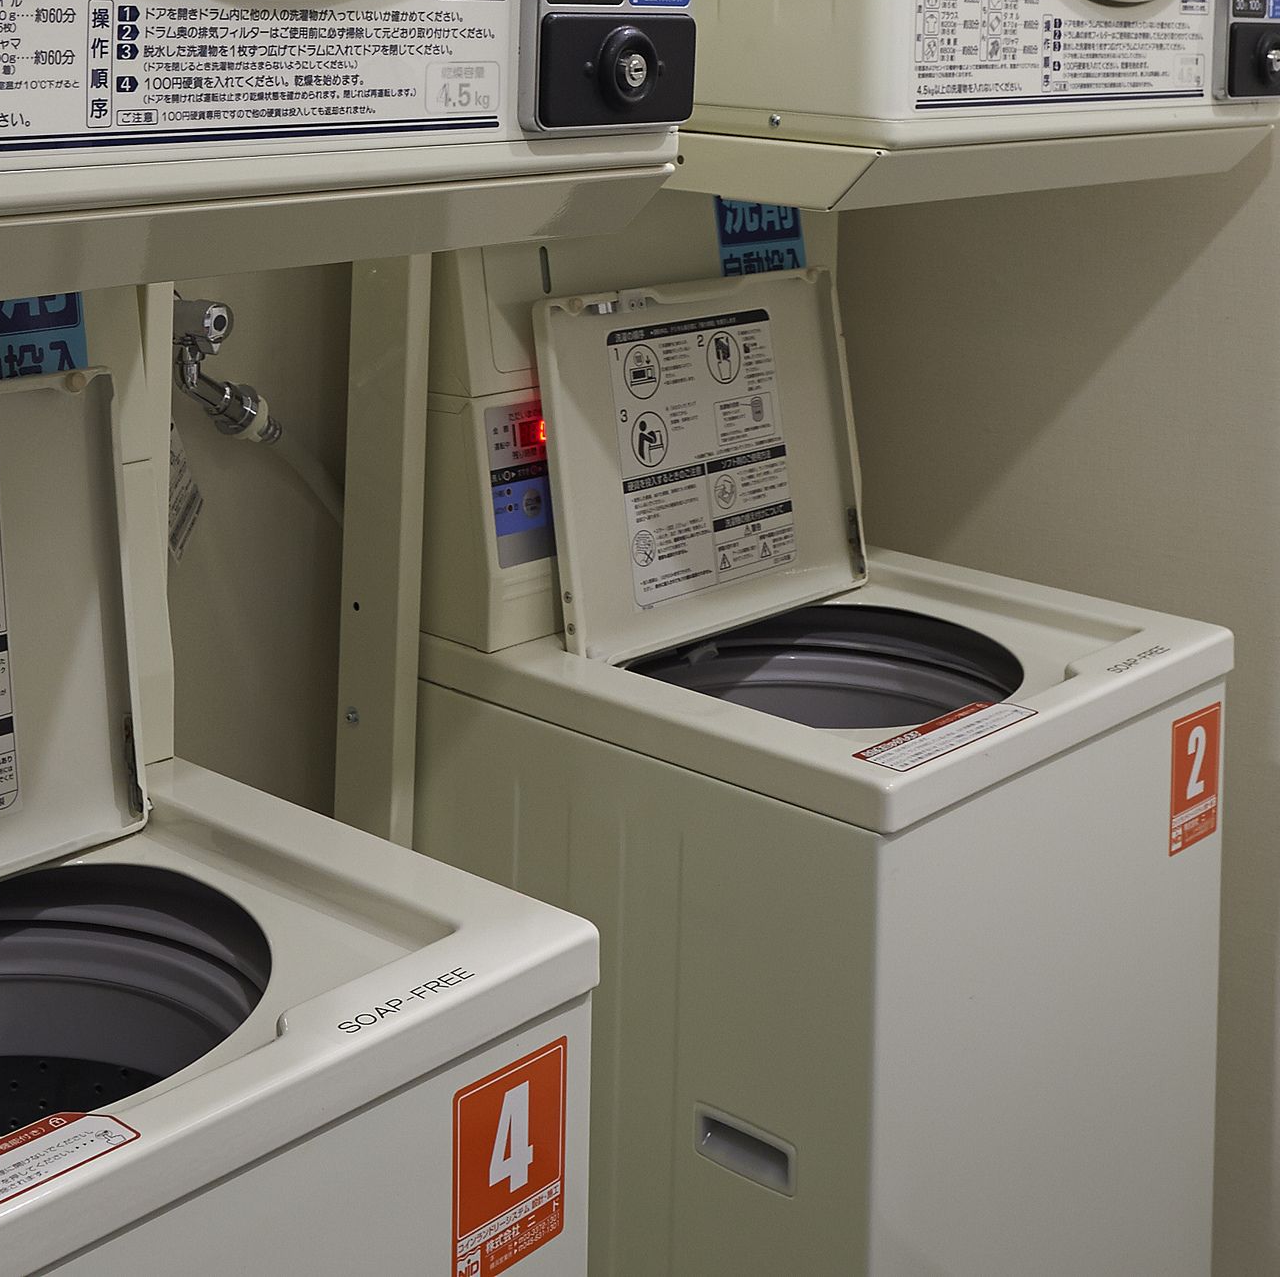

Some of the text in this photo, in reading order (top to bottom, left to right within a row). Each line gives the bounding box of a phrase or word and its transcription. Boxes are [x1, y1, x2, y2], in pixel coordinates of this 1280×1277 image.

[90, 8, 110, 119] 操作順序
[121, 112, 153, 123] ご注意
[696, 334, 704, 347] 2
[620, 409, 628, 423] 3
[1186, 726, 1206, 800] 2
[337, 967, 475, 1034] SOAP-FREE
[489, 1080, 533, 1194] 4
[486, 1224, 520, 1253] 株式会社
